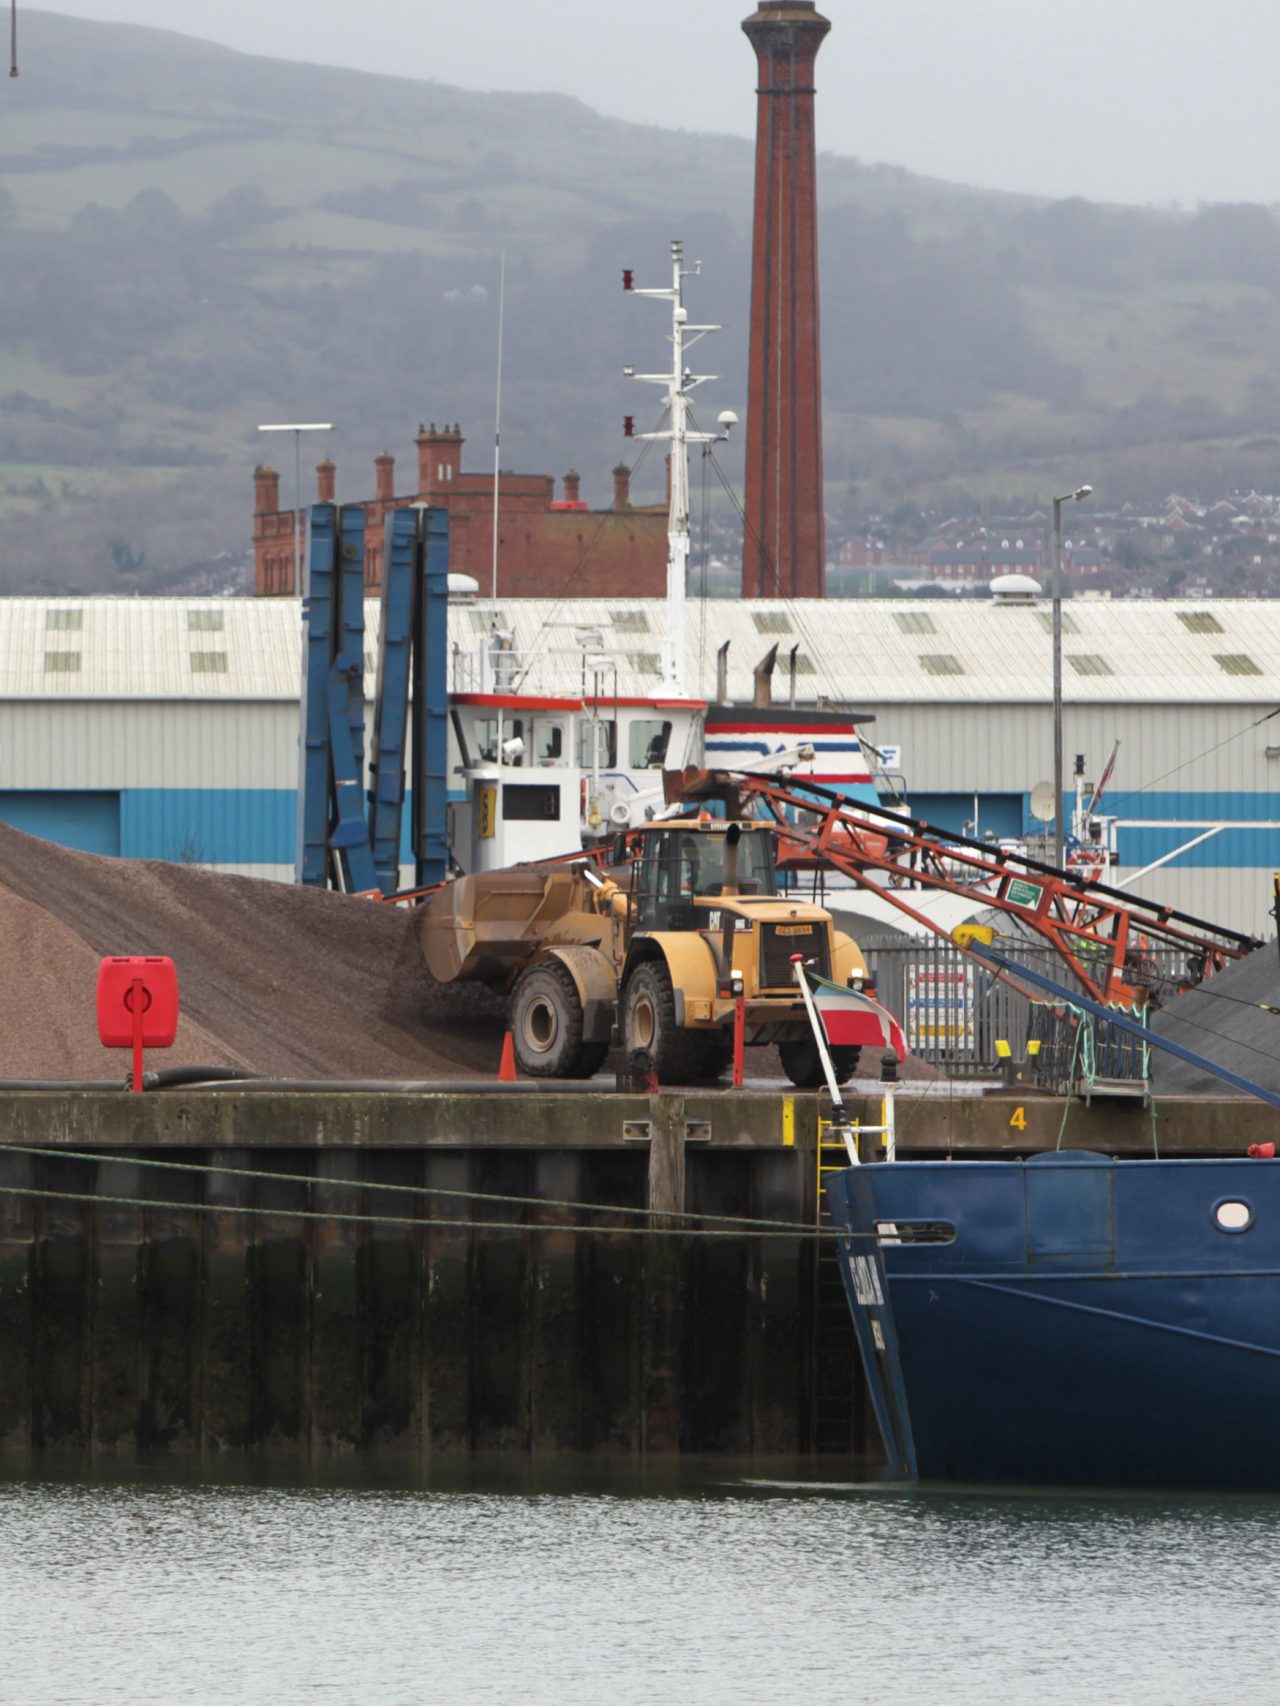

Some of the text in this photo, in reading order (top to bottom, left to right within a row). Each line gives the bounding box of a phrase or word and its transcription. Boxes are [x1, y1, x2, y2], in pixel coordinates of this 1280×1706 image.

[882, 749, 896, 764] F
[709, 911, 721, 931] CAT
[1009, 1106, 1027, 1131] 4
